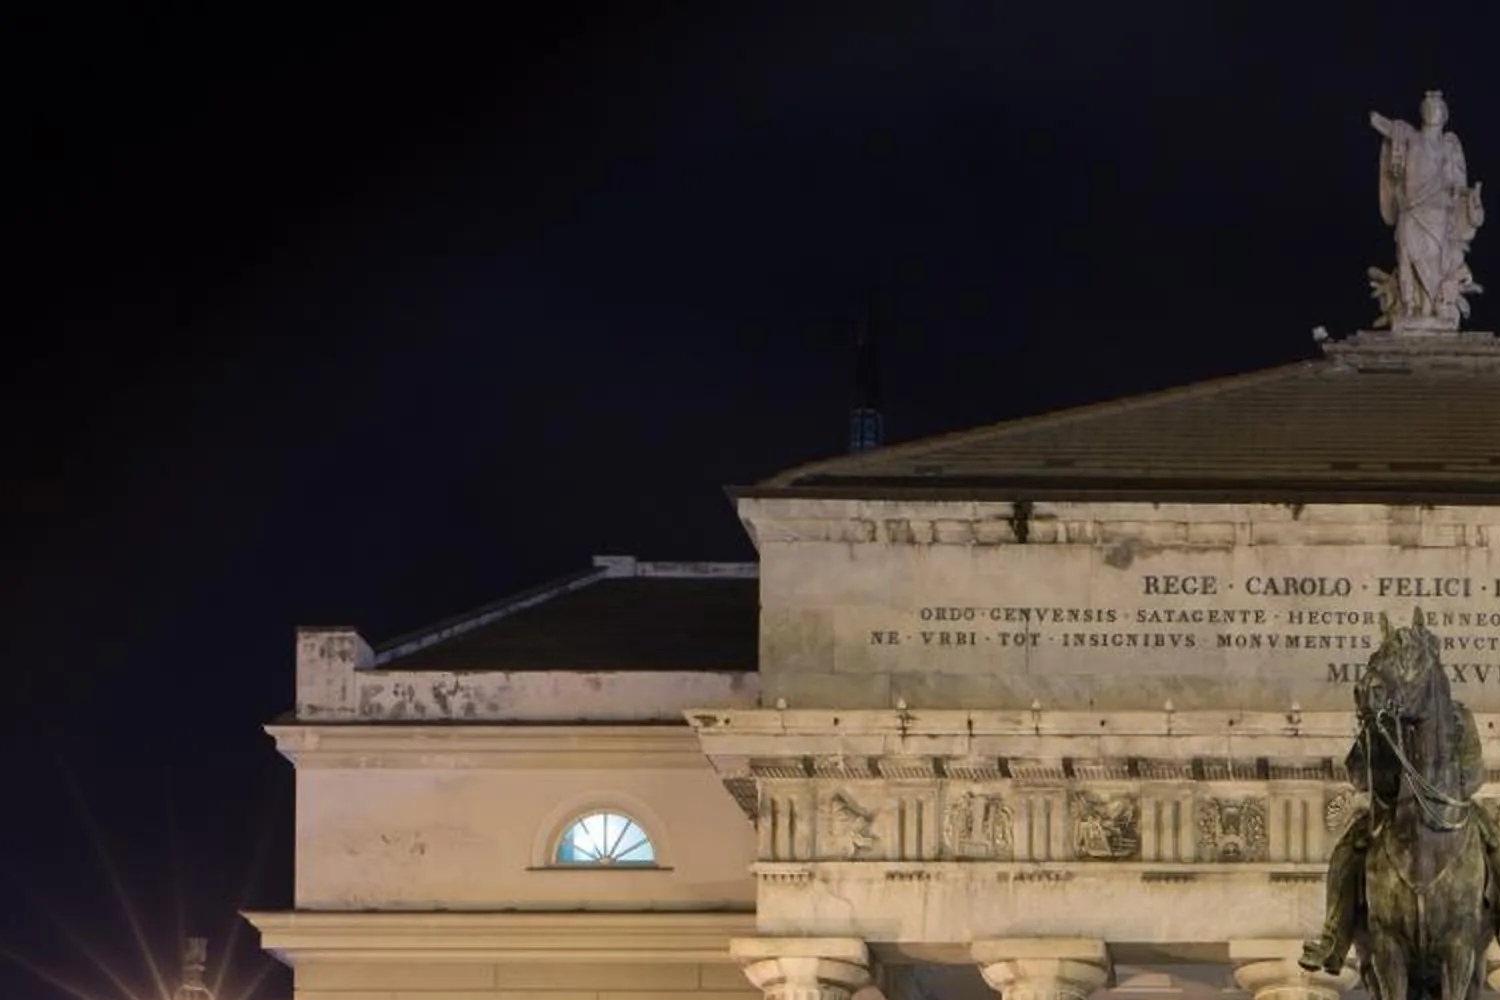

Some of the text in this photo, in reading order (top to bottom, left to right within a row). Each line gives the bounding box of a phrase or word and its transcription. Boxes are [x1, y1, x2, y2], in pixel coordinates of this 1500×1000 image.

[1143, 575, 1217, 596] REGE
[1245, 576, 1351, 597] CAROLO
[1378, 577, 1471, 598] FELICI
[920, 607, 975, 622] ORDO
[1289, 610, 1378, 626] HECTOR
[871, 631, 900, 646] NE
[920, 631, 977, 646] VRBI
[998, 632, 1041, 647] TOT
[1062, 633, 1196, 648] INSIGNIBVS
[1217, 634, 1372, 650] MONVMENTIS
